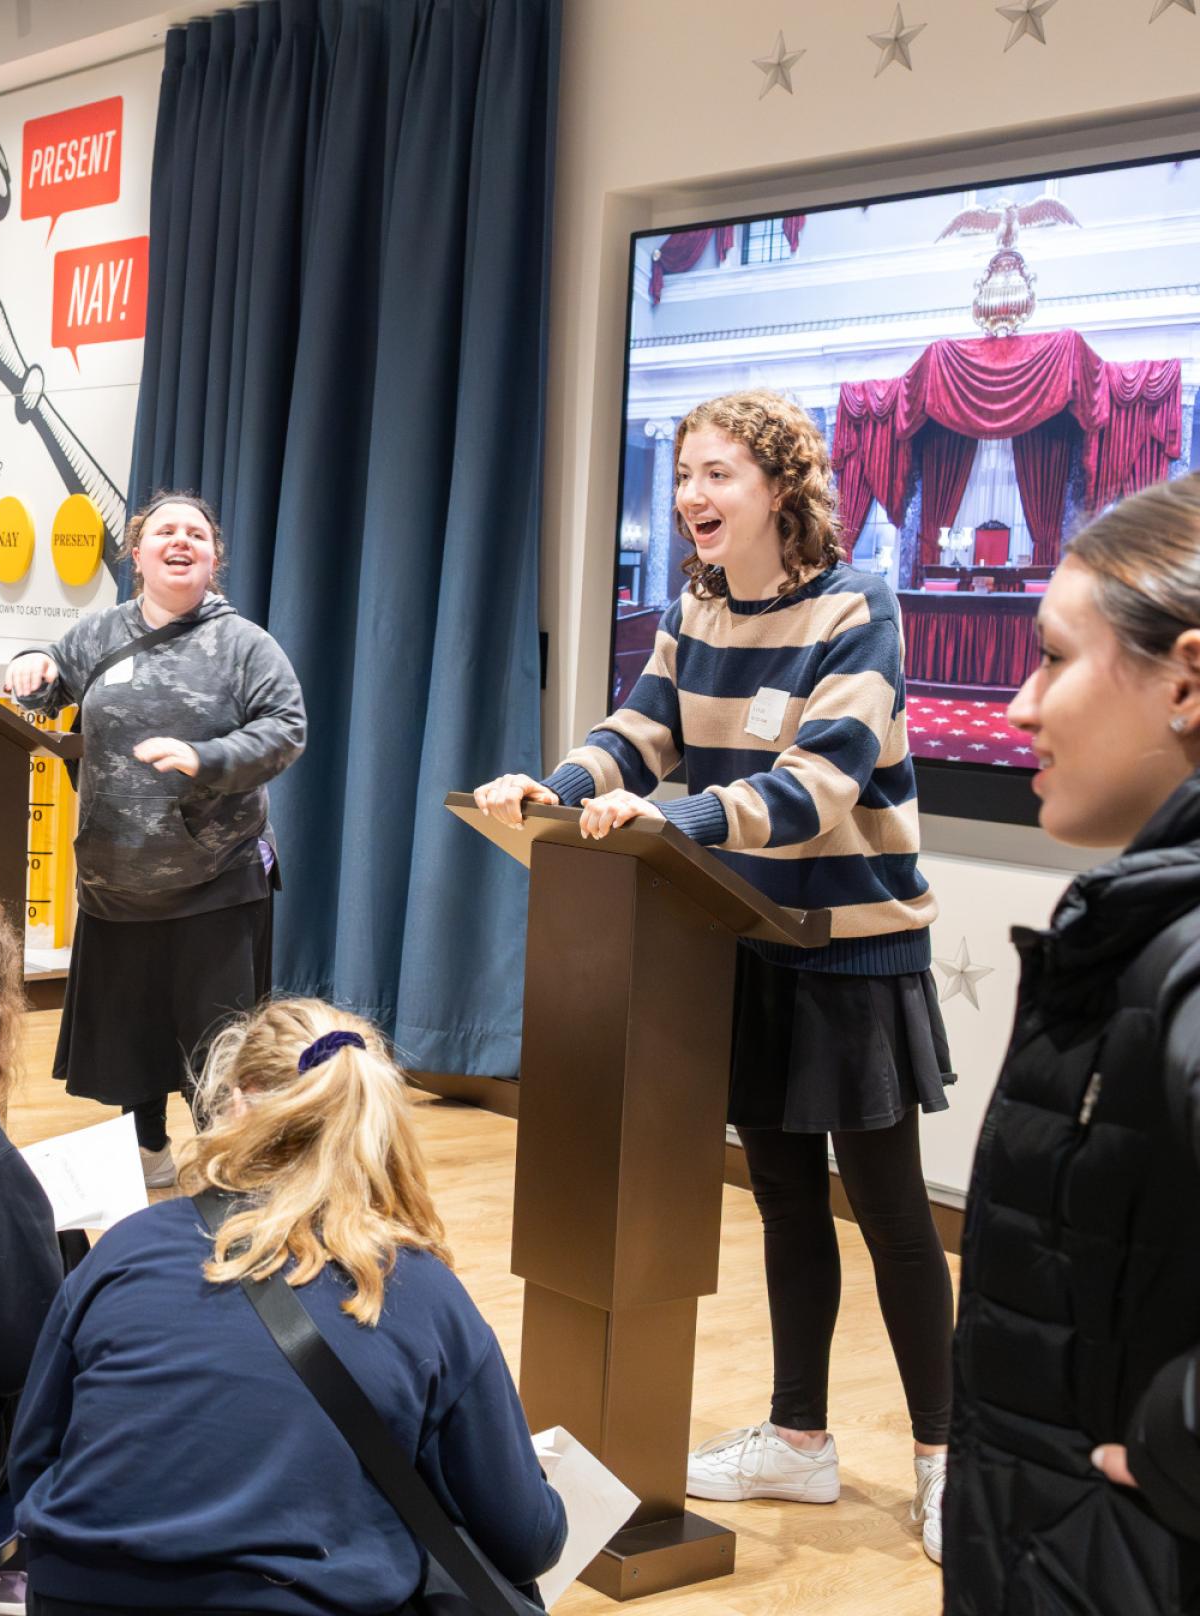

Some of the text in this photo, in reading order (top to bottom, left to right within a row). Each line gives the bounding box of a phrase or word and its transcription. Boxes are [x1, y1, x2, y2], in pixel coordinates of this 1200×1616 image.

[28, 129, 117, 190] PRESENT
[66, 257, 134, 328] NAY!
[53, 533, 97, 547] PRESENT
[16, 605, 25, 615] TO
[26, 606, 42, 616] CAST
[43, 606, 61, 618] YOUR
[62, 608, 80, 618] VOTE
